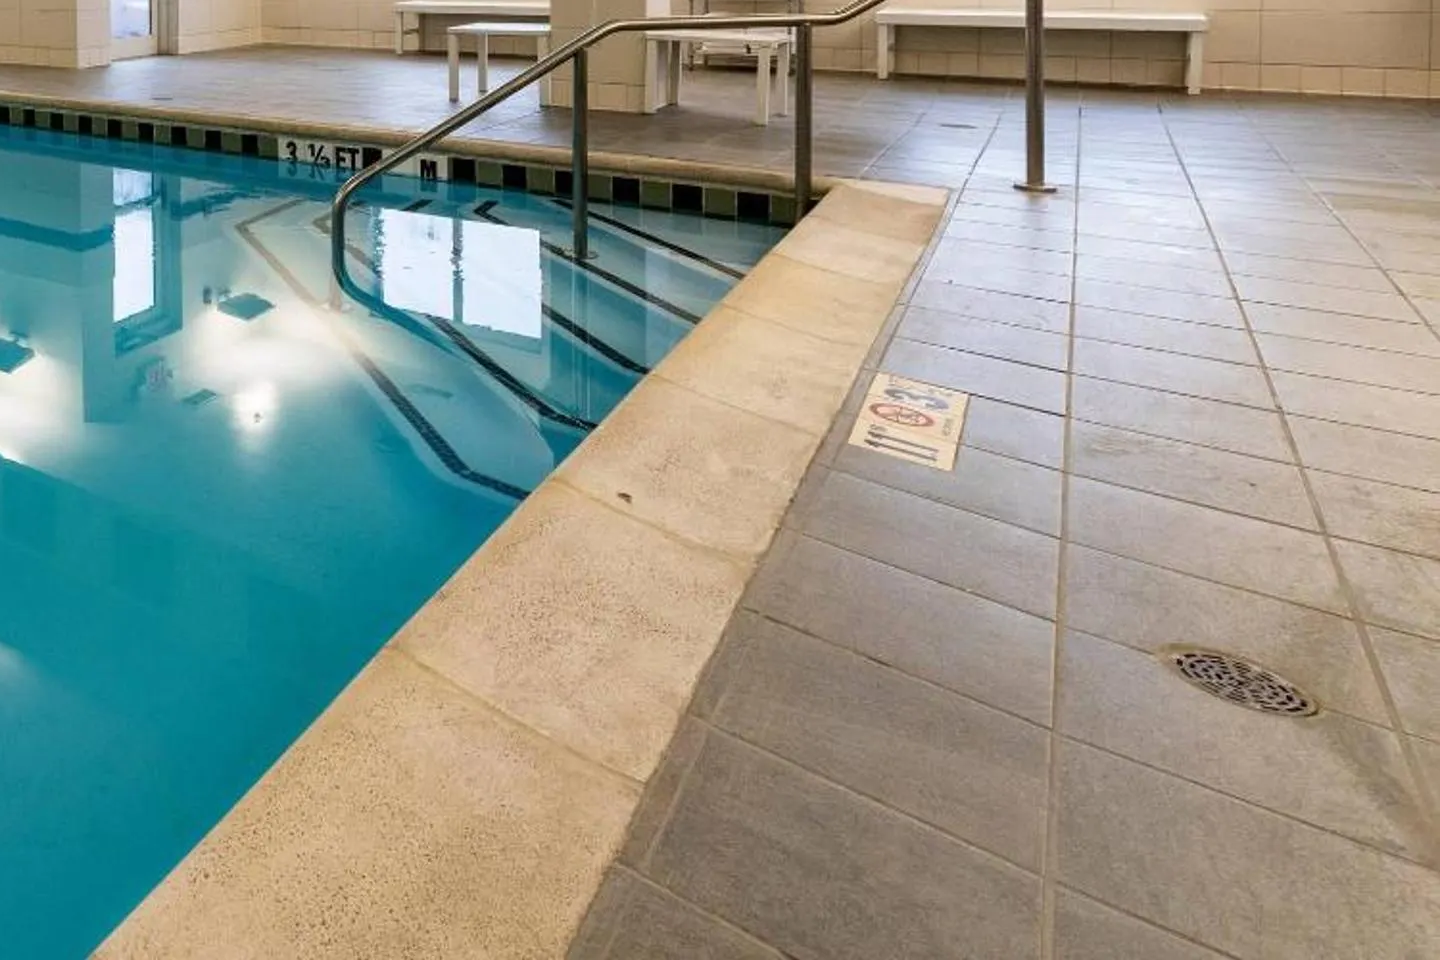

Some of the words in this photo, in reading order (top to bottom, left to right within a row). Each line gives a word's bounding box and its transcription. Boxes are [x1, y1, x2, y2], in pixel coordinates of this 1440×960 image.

[286, 141, 297, 161] 3
[335, 147, 360, 169] FT
[420, 158, 438, 180] M
